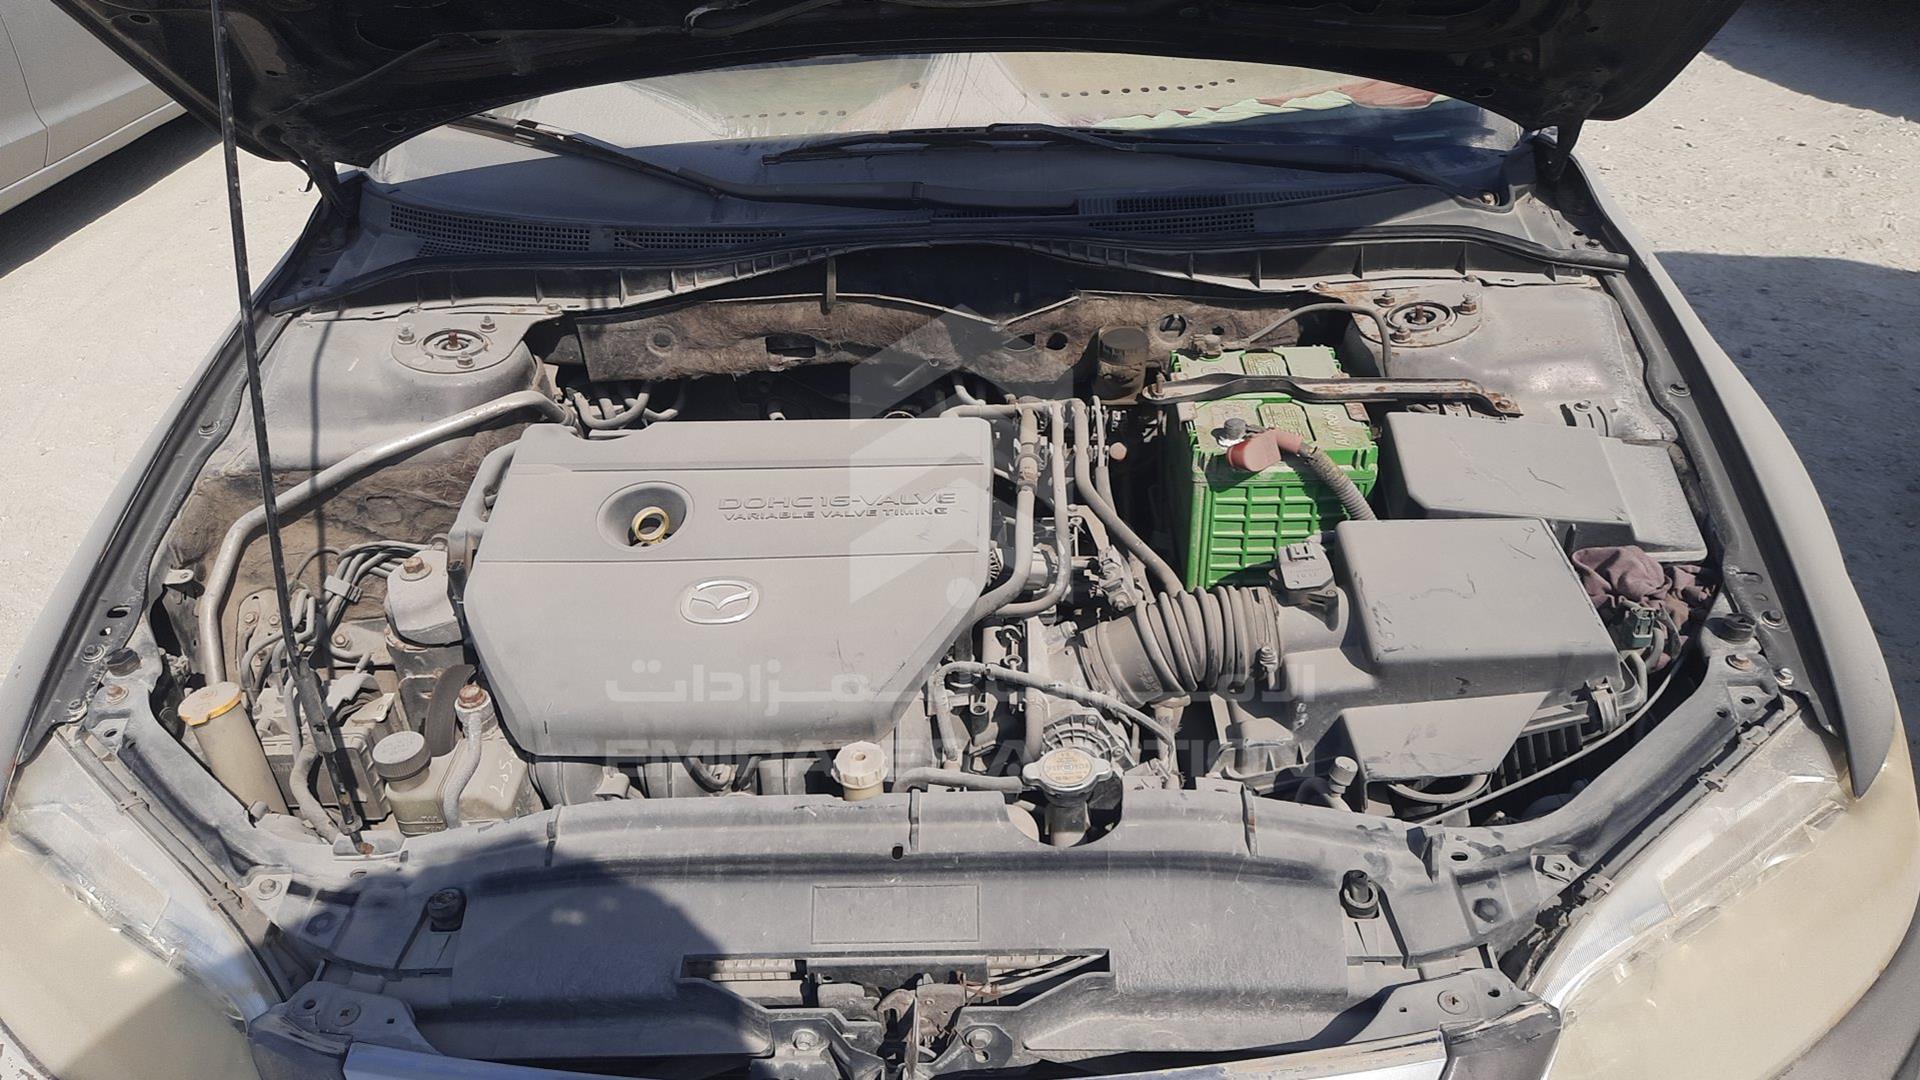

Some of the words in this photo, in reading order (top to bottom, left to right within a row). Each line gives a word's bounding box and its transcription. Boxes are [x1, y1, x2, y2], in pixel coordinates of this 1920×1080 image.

[717, 496, 814, 510] DOHC
[820, 492, 956, 508] 16-VALVE
[723, 511, 815, 521] VARIABLE
[820, 509, 877, 518] VALVE
[882, 507, 948, 517] TIMING
